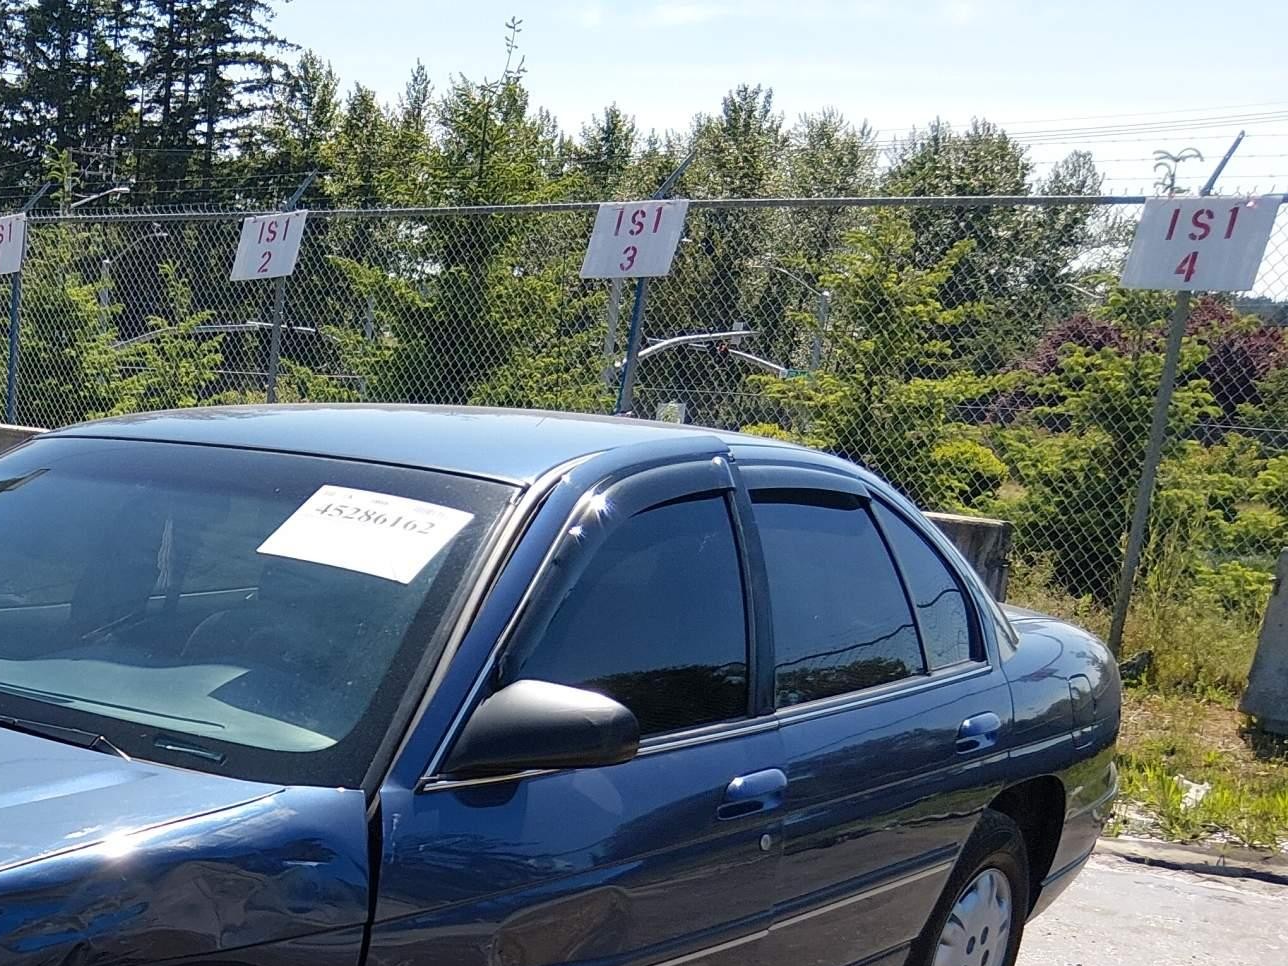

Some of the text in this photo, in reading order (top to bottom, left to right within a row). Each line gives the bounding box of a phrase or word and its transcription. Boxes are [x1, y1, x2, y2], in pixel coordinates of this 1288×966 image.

[257, 250, 272, 273] 2
[619, 246, 638, 272] 3
[1173, 251, 1199, 283] 4
[315, 503, 436, 535] 45286162
